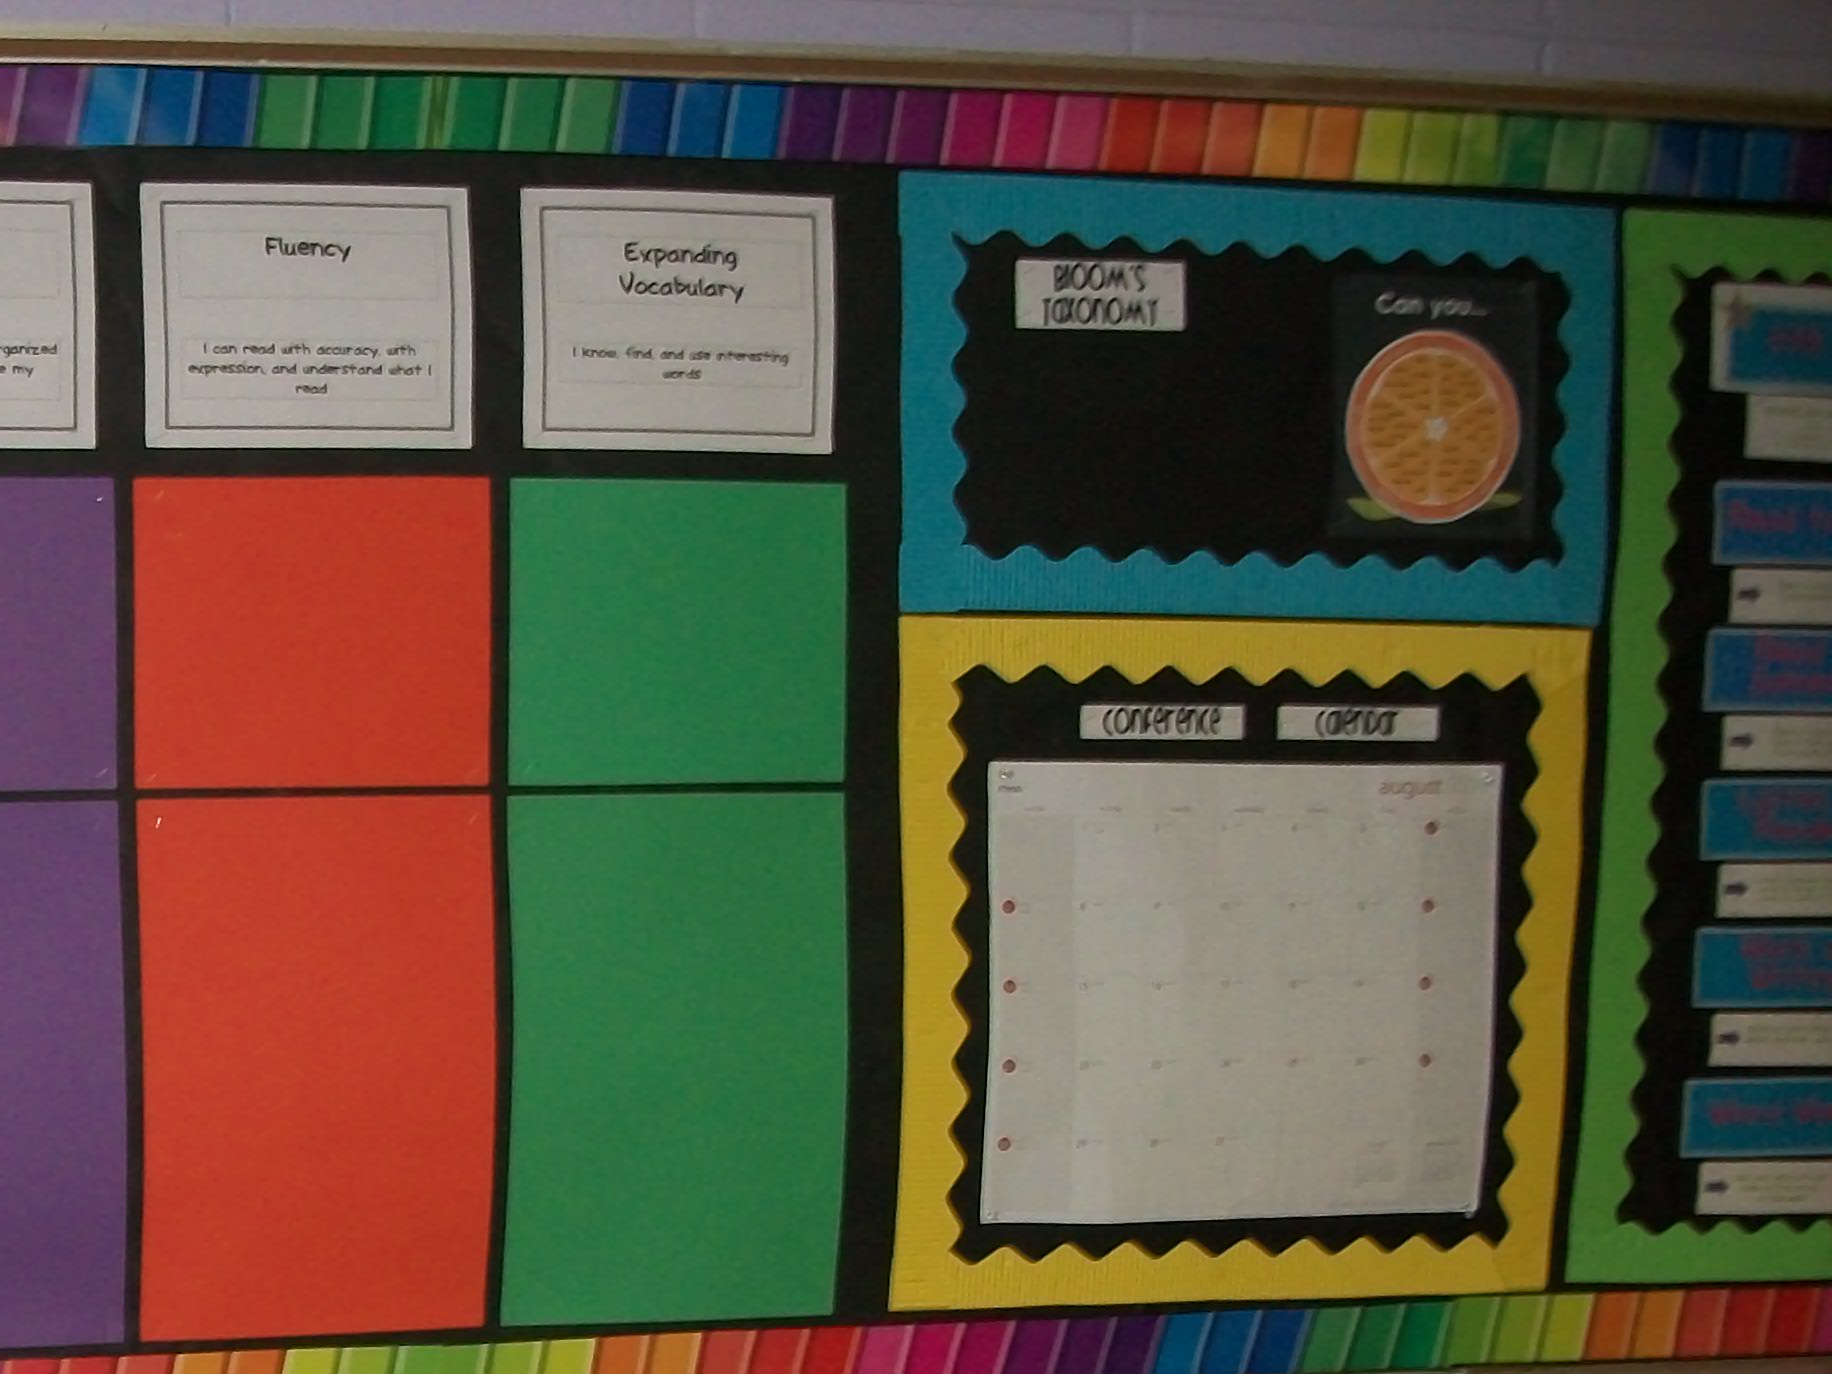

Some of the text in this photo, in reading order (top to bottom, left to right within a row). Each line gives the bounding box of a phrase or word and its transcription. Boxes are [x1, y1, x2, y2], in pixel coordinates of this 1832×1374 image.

[264, 237, 351, 263] Fluency
[624, 241, 738, 271] Expanding
[619, 271, 744, 304] Vocabulary
[1374, 290, 1425, 315] Can
[212, 345, 237, 355] can
[243, 343, 275, 355] read
[281, 343, 311, 355] with
[386, 344, 416, 356] with
[660, 349, 684, 361] and
[689, 350, 711, 361] use
[716, 349, 789, 366] interesting
[12, 365, 34, 378] my
[272, 363, 297, 375] and
[303, 363, 382, 375] understand
[388, 364, 422, 376] what
[662, 369, 702, 380] words
[295, 383, 328, 394] read
